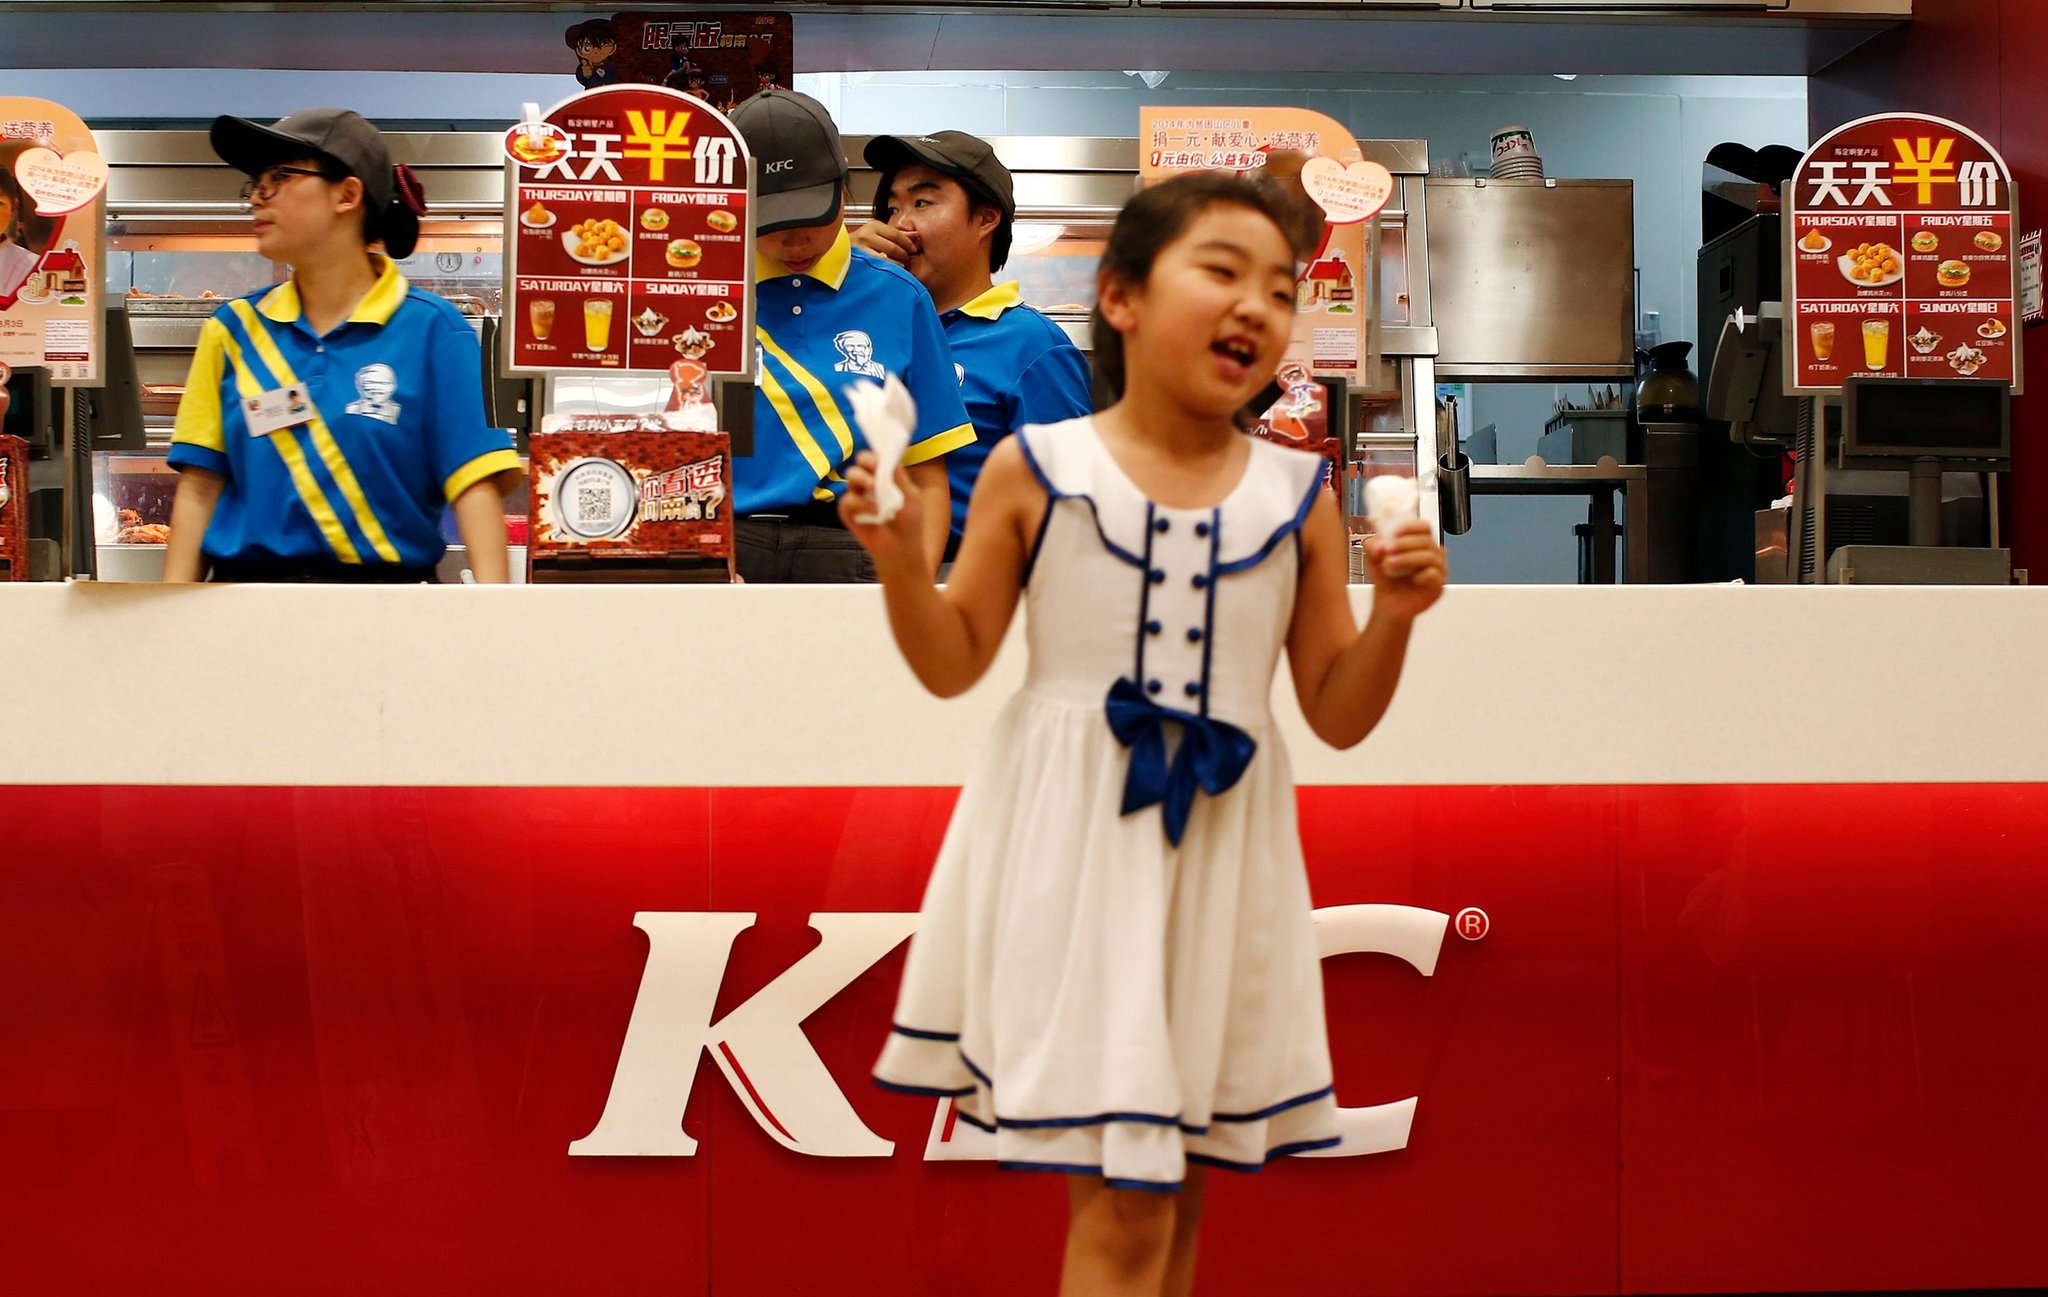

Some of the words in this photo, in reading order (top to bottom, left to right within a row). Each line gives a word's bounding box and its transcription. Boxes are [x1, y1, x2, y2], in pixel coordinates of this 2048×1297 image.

[765, 159, 794, 174] KFC
[1807, 137, 1999, 207] 天天半价
[568, 902, 1451, 1161] KC
